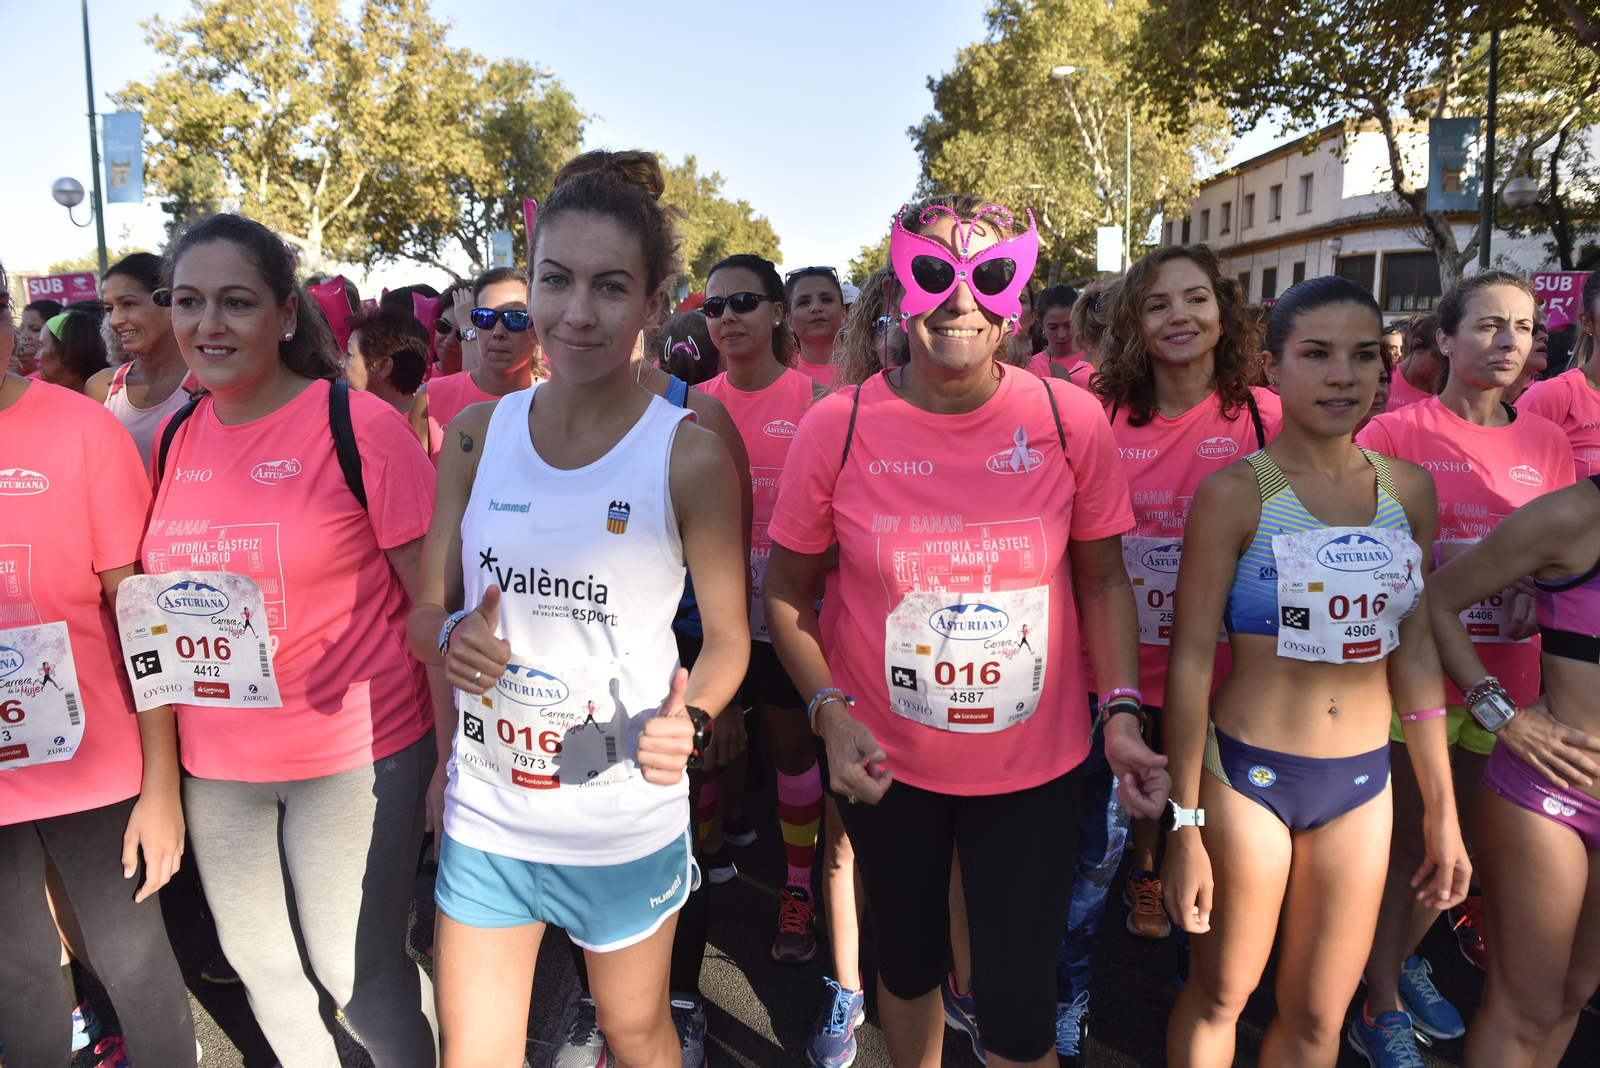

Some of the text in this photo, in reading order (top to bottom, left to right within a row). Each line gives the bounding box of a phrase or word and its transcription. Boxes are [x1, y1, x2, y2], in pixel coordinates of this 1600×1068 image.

[29, 278, 64, 295] SUB
[1534, 275, 1573, 292] SUB
[868, 460, 934, 476] OYSHO
[1133, 489, 1173, 505] GANAN
[488, 499, 532, 513] hummel
[1453, 502, 1488, 519] GANAN
[1145, 510, 1175, 520] VITORIA
[165, 519, 211, 537] GANAN
[871, 514, 963, 534] HOY GANAN
[1461, 522, 1491, 533] VITORIA
[170, 542, 208, 555] VITORIA
[217, 538, 259, 551] GASTEIZ
[925, 538, 971, 554] VITORIA
[983, 536, 1030, 551] GASTEIZ
[191, 552, 231, 566] MADRID
[951, 551, 999, 565] MADRID
[1324, 549, 1389, 564] ASTURIANA
[1373, 570, 1401, 581] Carrera
[495, 567, 608, 605] València
[164, 595, 225, 609] ASTURIANA
[1328, 593, 1389, 621] 016
[210, 616, 237, 626] Carrera
[935, 614, 1003, 631] ASTURIANA
[1467, 610, 1493, 620] 4406
[1344, 624, 1377, 638] 4906
[175, 635, 231, 661] 016
[983, 639, 1012, 650] Carrera
[1283, 641, 1326, 655] OYSHO
[193, 664, 220, 678] 4412
[934, 661, 1002, 686] 016
[20, 684, 44, 698] Mujer
[143, 683, 183, 699] OYSHO
[950, 692, 984, 703] 4587
[539, 708, 575, 720] Carrera
[898, 698, 989, 720] OYSHO Santander
[560, 720, 586, 734] Mujer
[496, 718, 563, 754] 016
[47, 747, 74, 756] ZURICH
[511, 752, 546, 770] 7973
[464, 752, 554, 787] OYSHO Santander
[578, 780, 610, 788] ZURICH
[649, 874, 682, 908] hummel
